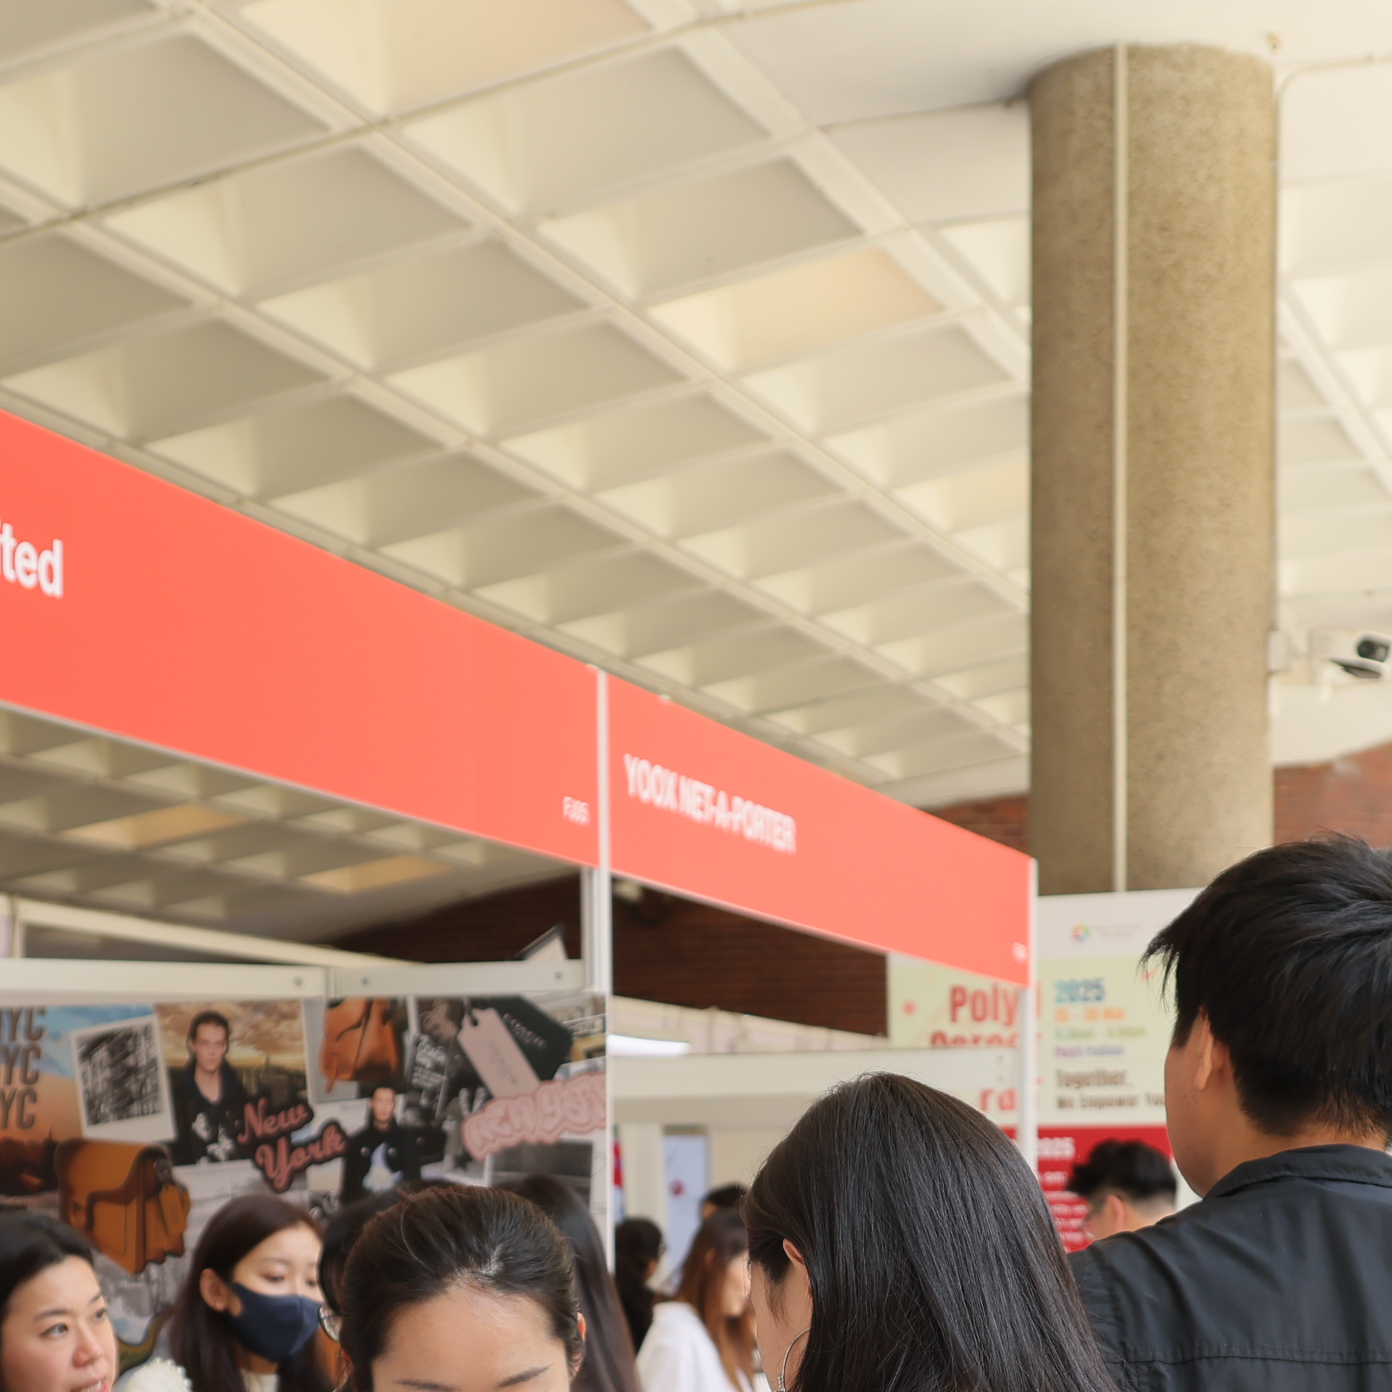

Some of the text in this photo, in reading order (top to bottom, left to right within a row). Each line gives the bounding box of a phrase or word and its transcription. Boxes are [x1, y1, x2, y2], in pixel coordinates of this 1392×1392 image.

[624, 753, 796, 854] YOOX NET-A-PORTER
[1054, 977, 1106, 1003] 2025
[237, 1097, 310, 1144] New
[255, 1122, 346, 1190] York
